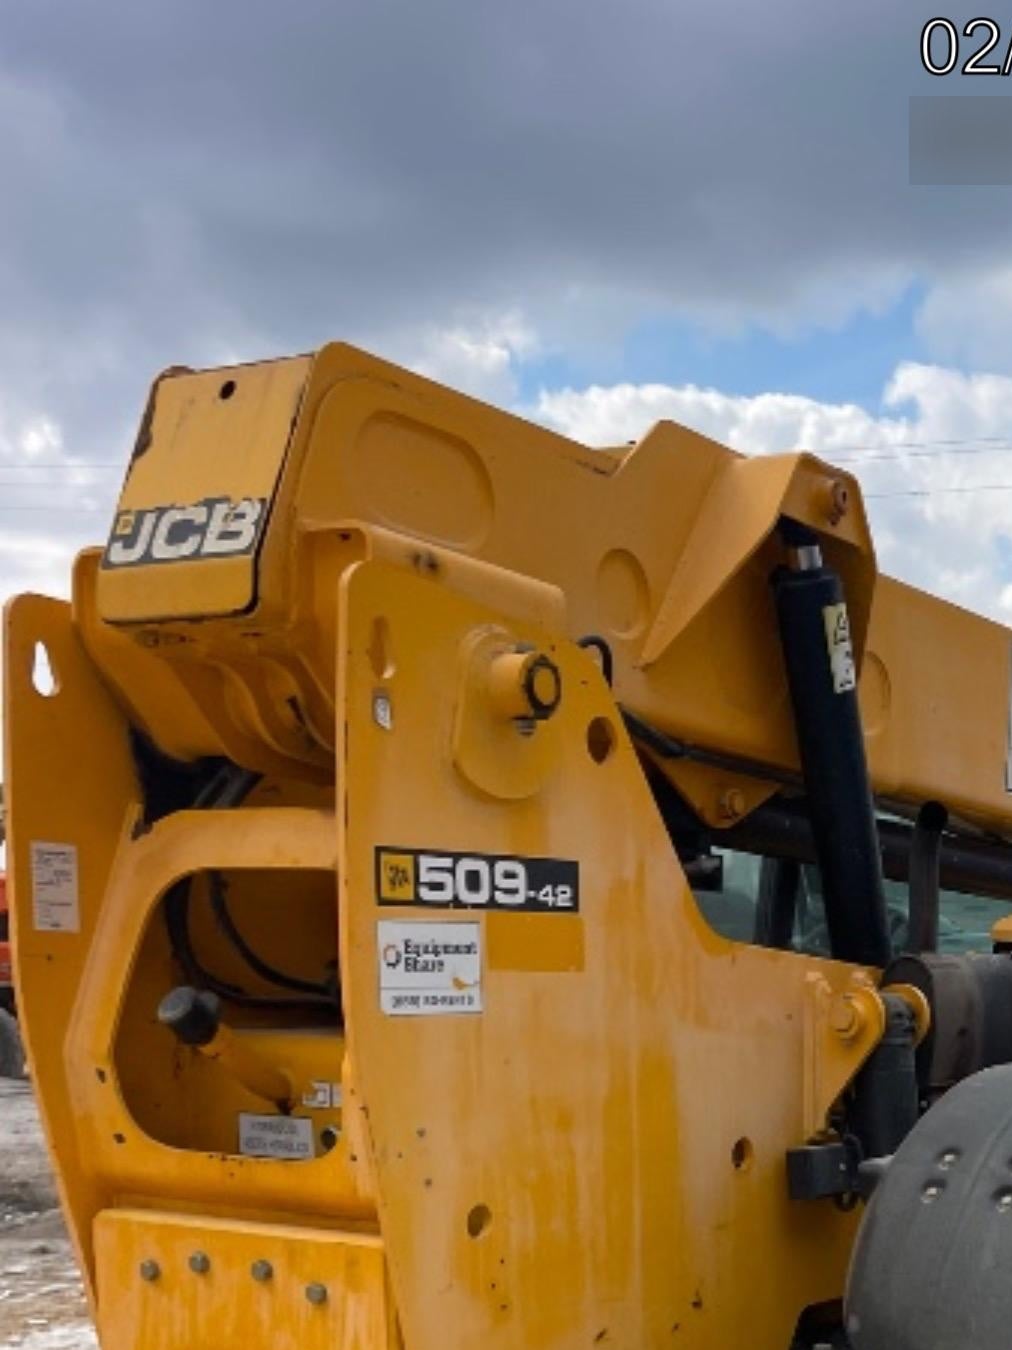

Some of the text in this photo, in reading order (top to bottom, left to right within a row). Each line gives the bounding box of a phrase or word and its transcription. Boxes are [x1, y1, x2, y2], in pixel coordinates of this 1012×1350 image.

[109, 500, 262, 565] JCB
[417, 854, 574, 907] 509-42
[403, 938, 477, 958] Equipment
